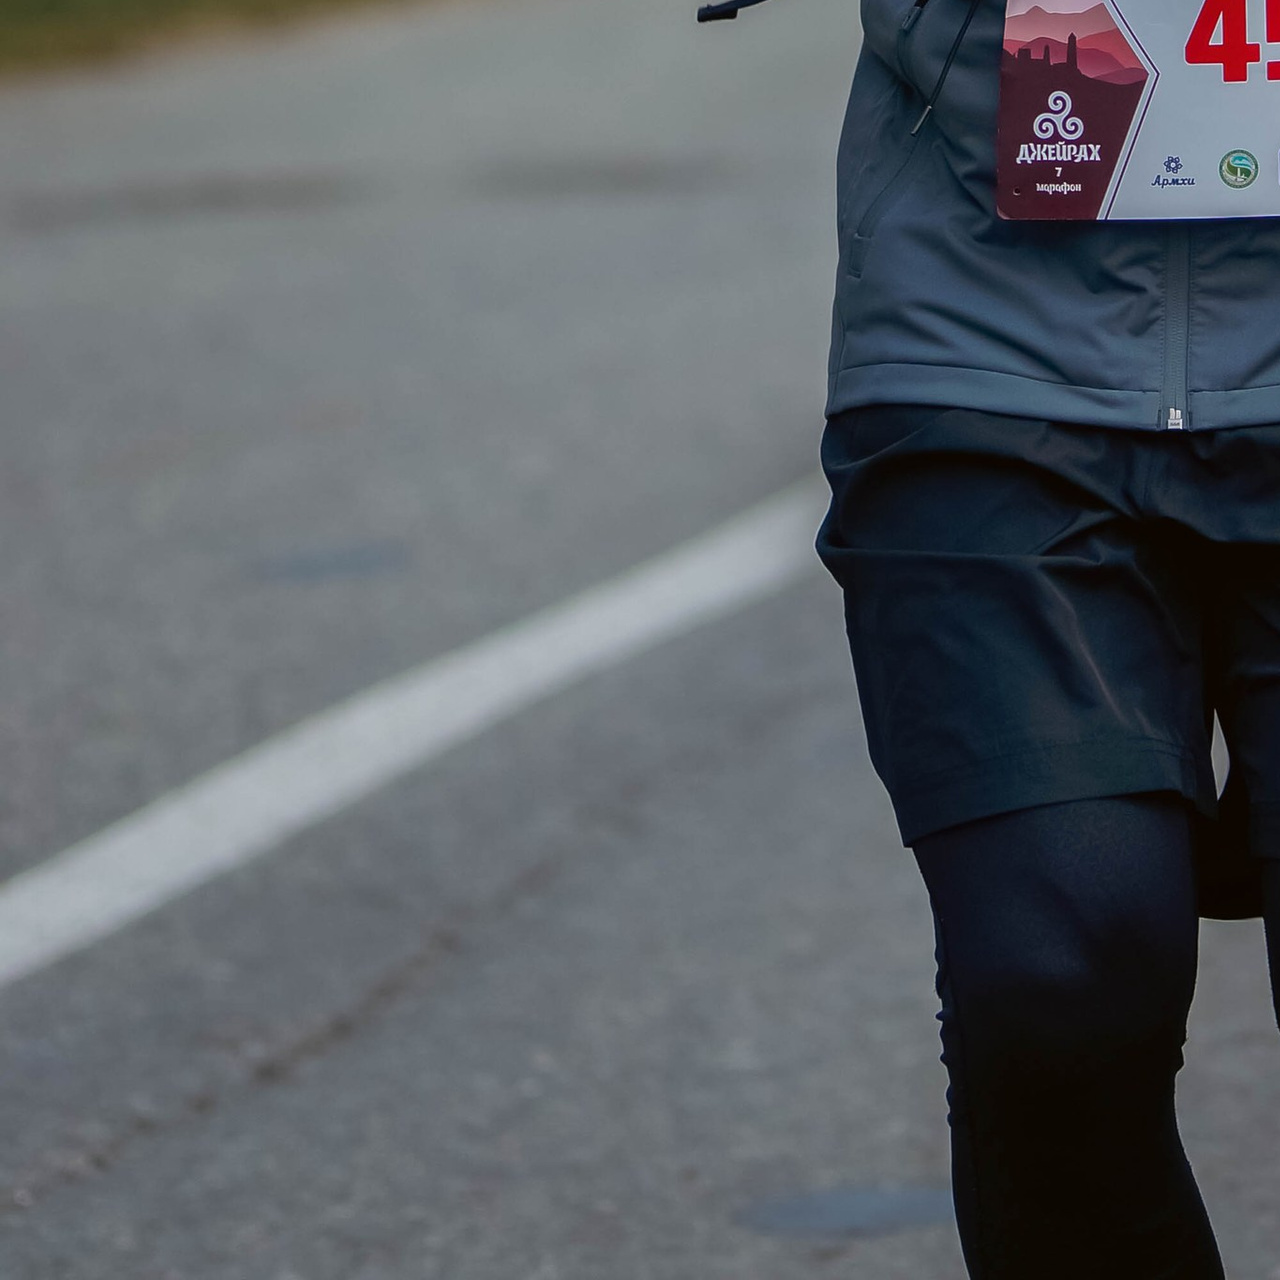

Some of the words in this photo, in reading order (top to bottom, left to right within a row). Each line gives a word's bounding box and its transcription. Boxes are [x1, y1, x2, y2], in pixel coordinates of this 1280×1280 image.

[1016, 141, 1101, 164] ДЖЕЙРАХ
[1054, 167, 1063, 177] 7
[1036, 182, 1082, 195] марафон
[1151, 174, 1196, 189] Армхи
